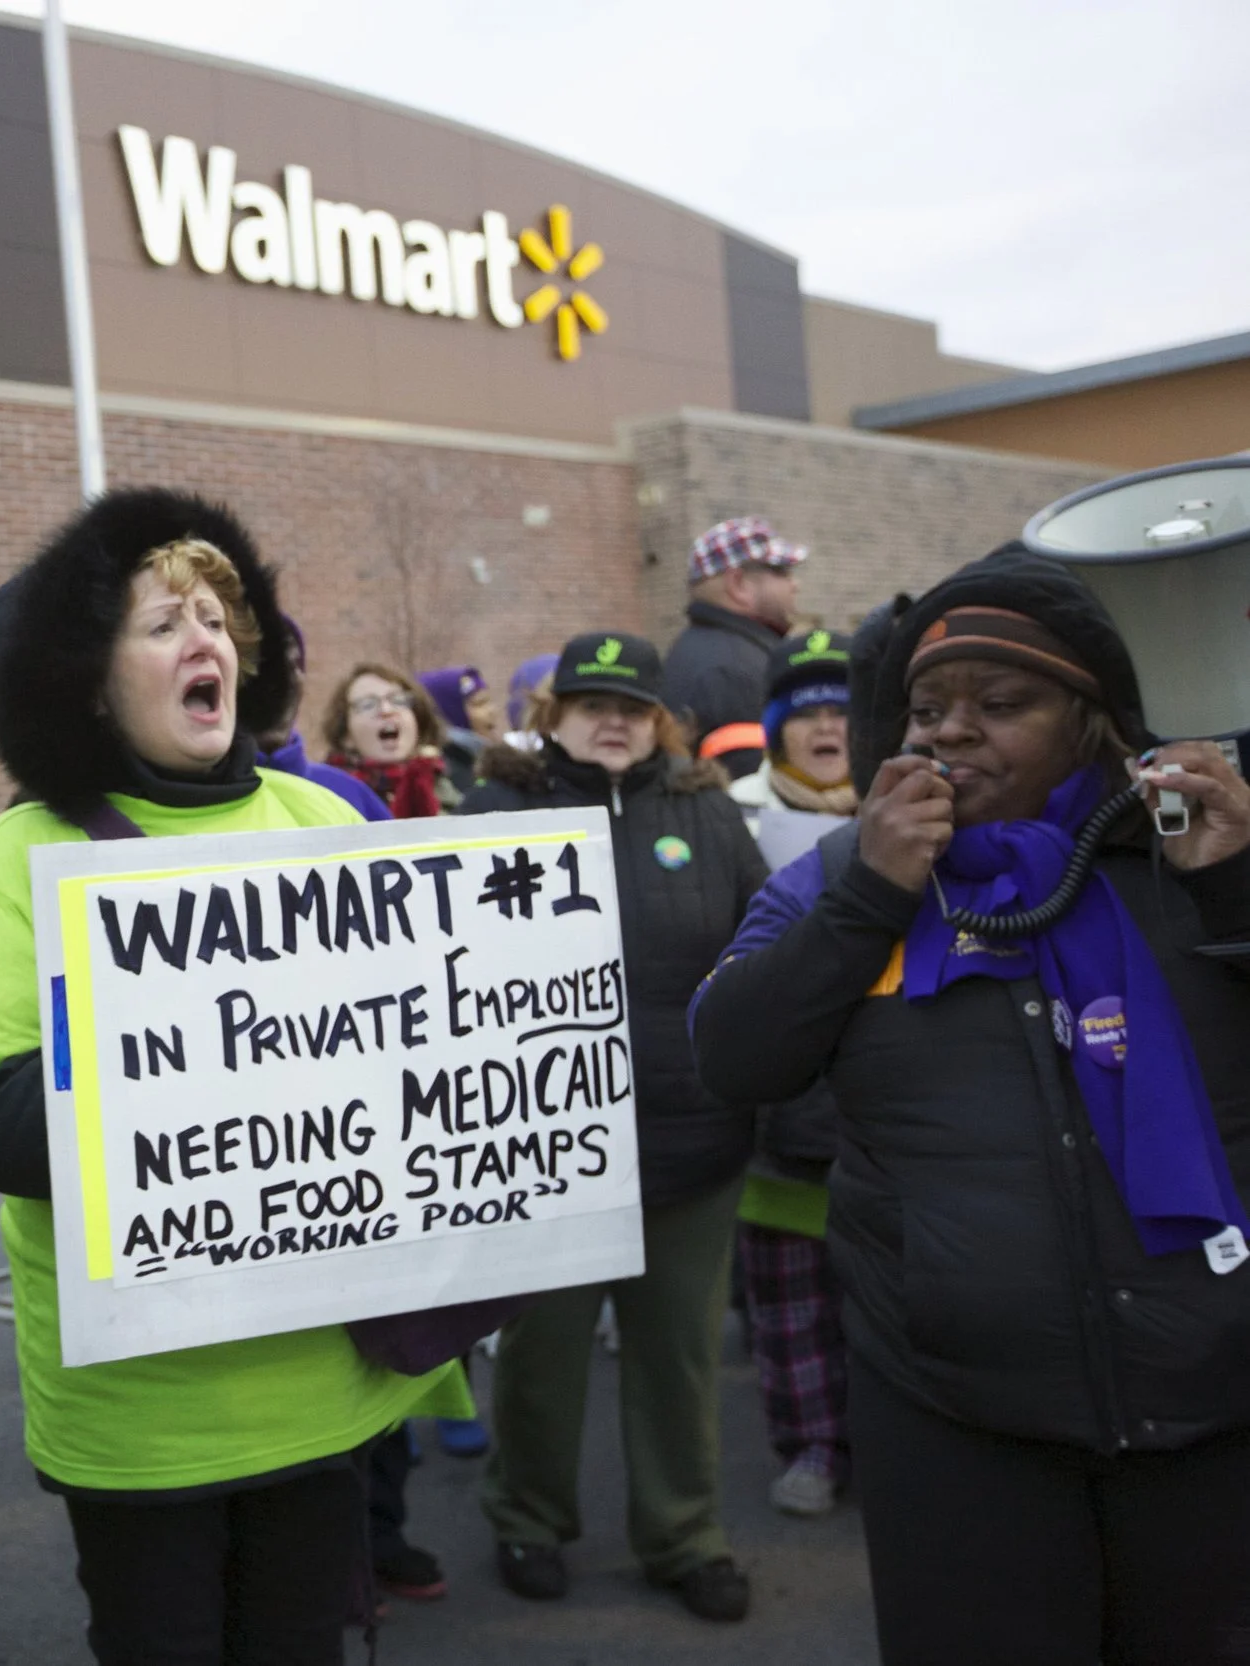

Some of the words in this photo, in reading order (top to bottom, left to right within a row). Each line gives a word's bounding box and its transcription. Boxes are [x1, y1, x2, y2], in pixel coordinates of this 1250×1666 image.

[119, 125, 524, 328] Walmart
[98, 855, 462, 975] WALMART
[478, 843, 601, 919] #1
[121, 1026, 186, 1080] IN
[216, 985, 428, 1071] PRIVATE
[445, 946, 625, 1044] EMPLOYEES
[134, 1100, 376, 1190] NEEDING
[402, 1036, 632, 1142] MEDICAID
[122, 1199, 234, 1257] AND
[260, 1169, 384, 1232] FOOD
[406, 1124, 610, 1199] STAMPS
